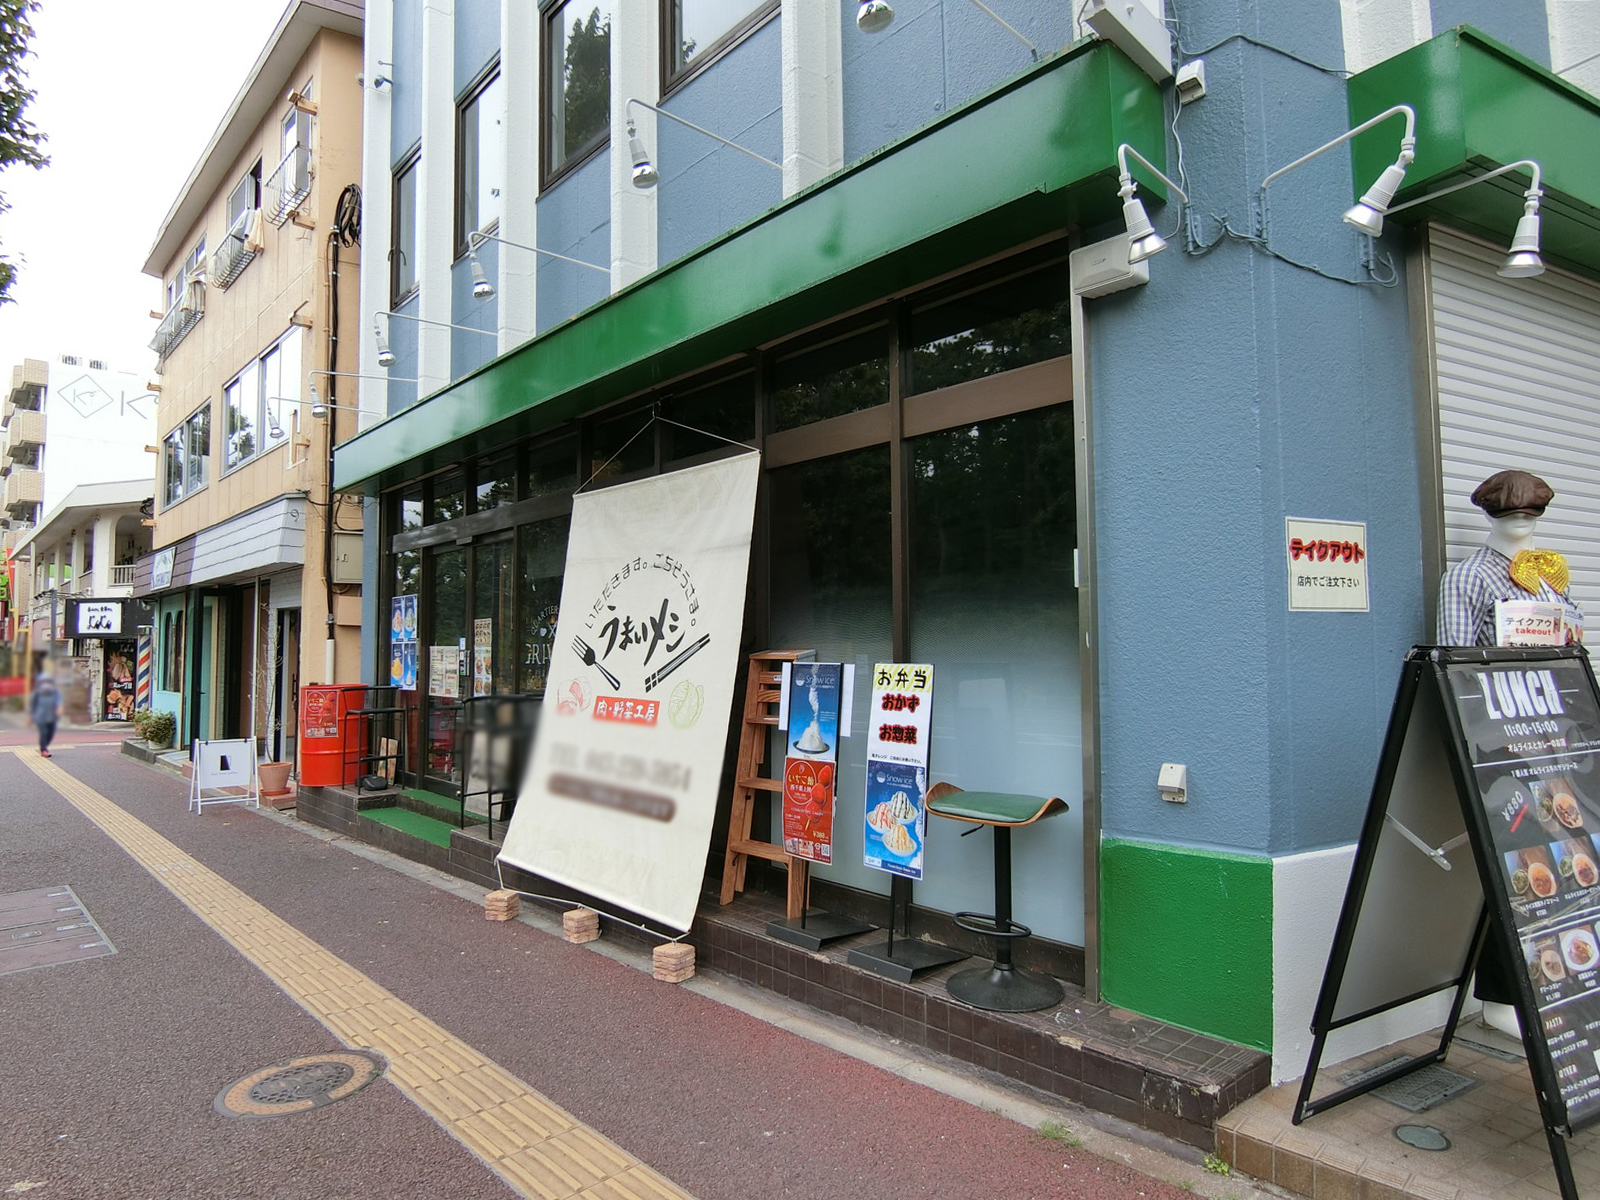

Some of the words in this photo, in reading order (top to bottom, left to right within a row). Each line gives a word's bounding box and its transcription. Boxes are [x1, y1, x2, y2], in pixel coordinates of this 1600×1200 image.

[1290, 538, 1365, 564] テイクアウト
[584, 557, 648, 629] いただきます。
[653, 553, 700, 627] ごちそうさま。
[1297, 575, 1360, 588] 店内でご注文下さい
[598, 598, 686, 667] うまいメシ
[1505, 617, 1552, 628] テイクアウ
[1515, 627, 1552, 636] takeout
[877, 668, 927, 689] お弁当
[882, 693, 920, 713] おかず
[1477, 670, 1564, 720] LUNCH
[879, 724, 917, 745] お惣菜
[1504, 720, 1559, 737] 11:00-15:00
[1501, 790, 1524, 822] ¥880
[1545, 1016, 1563, 1030] PASTA
